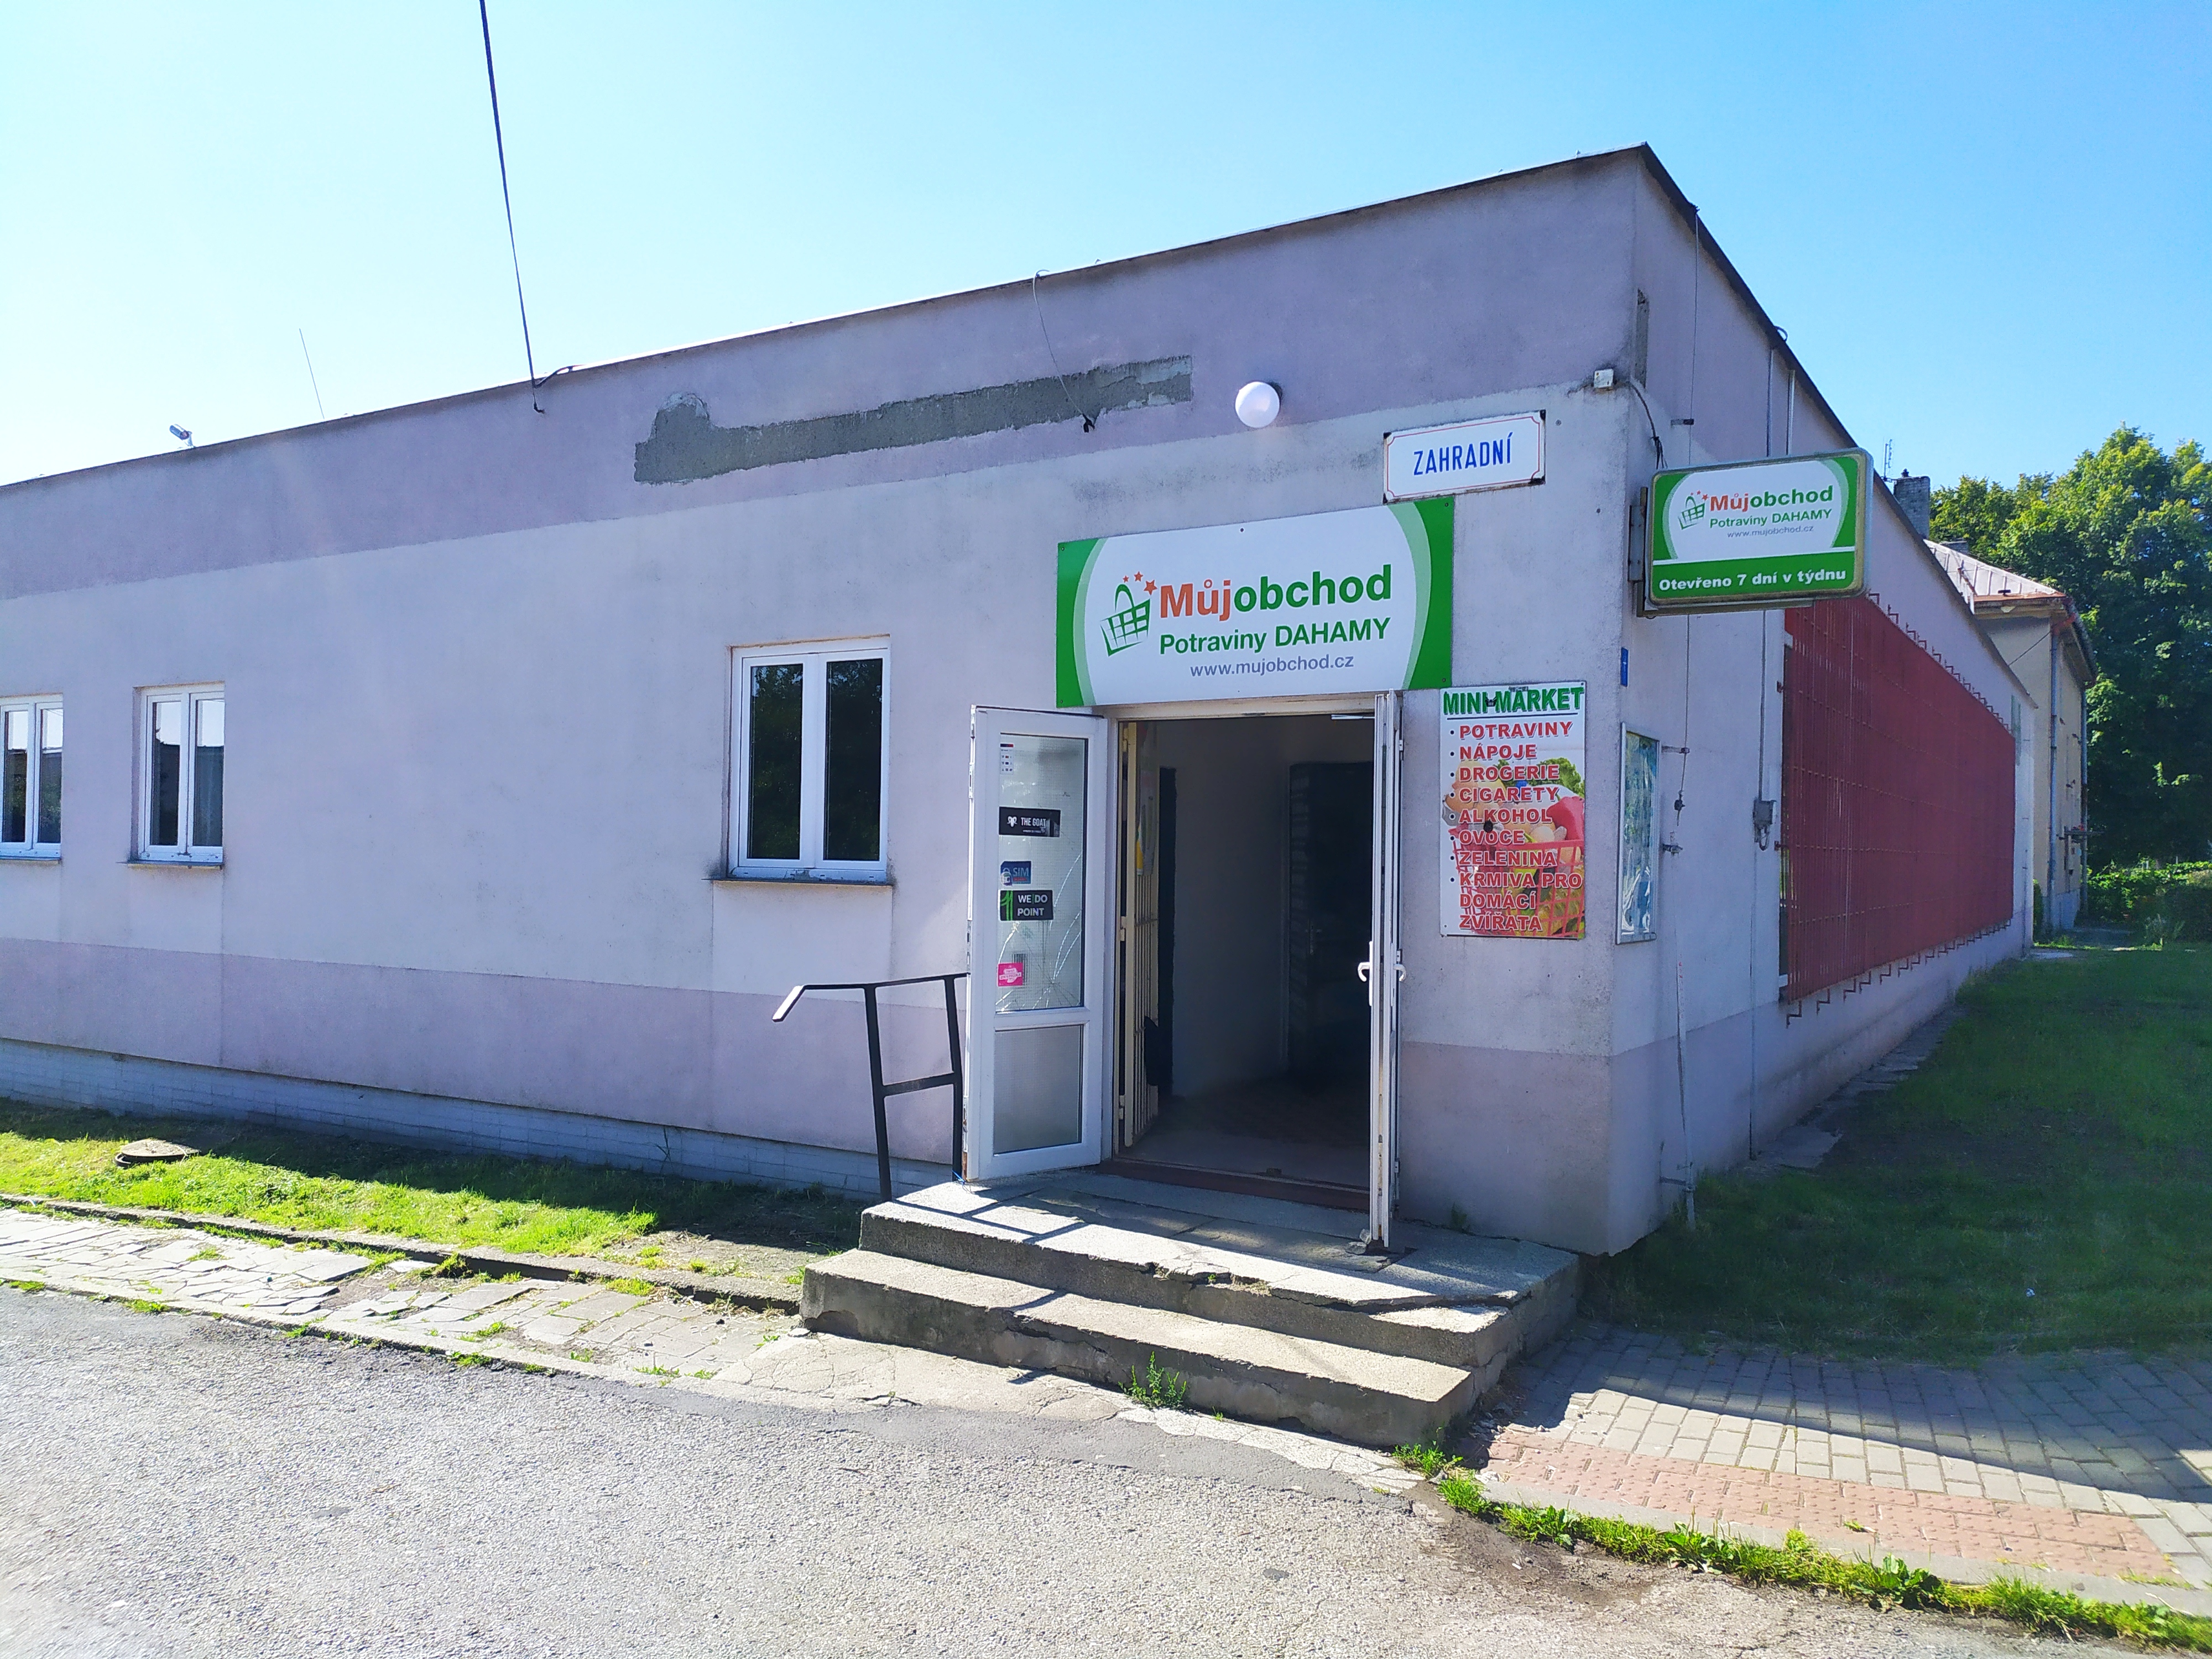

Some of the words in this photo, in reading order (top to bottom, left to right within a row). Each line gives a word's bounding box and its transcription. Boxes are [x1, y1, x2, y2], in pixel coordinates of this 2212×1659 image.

[1413, 432, 1514, 476] ZAHRADNÍ
[1710, 484, 1833, 512] Můjobchod
[1772, 508, 1833, 523] DAHAMY
[1727, 525, 1814, 538] www.mujobchod.cz
[1659, 576, 1732, 592] Otevřeno
[1738, 574, 1747, 586] 7
[1752, 571, 1777, 585] dní
[1783, 573, 1793, 583] v
[1797, 568, 1846, 585] týdnu
[1160, 564, 1392, 622] Můjobchod
[1160, 629, 1267, 655] Potraviny
[1275, 617, 1391, 647] DAHAMY
[1190, 654, 1354, 677] www.mujobchod.cz
[1495, 687, 1584, 713] MARKET
[1459, 721, 1573, 739] POTRAVINY
[1459, 743, 1537, 760] NÁPOJE
[1459, 764, 1561, 782] DROGERIE
[1459, 786, 1561, 803] CIGARETY
[1020, 817, 1032, 826] THE
[1032, 818, 1046, 827] GOAT
[1458, 808, 1553, 825] ALKOHOL
[1459, 830, 1525, 846] OVOCE
[1458, 850, 1558, 868] ZELENINA
[1013, 867, 1029, 877] SIM
[1459, 872, 1536, 889] KRMIVA
[1541, 872, 1583, 889] PRO
[1459, 890, 1537, 910] DOMÁCÍ
[1017, 907, 1045, 916] POINT
[1458, 913, 1542, 931] ZVÍŘATA
